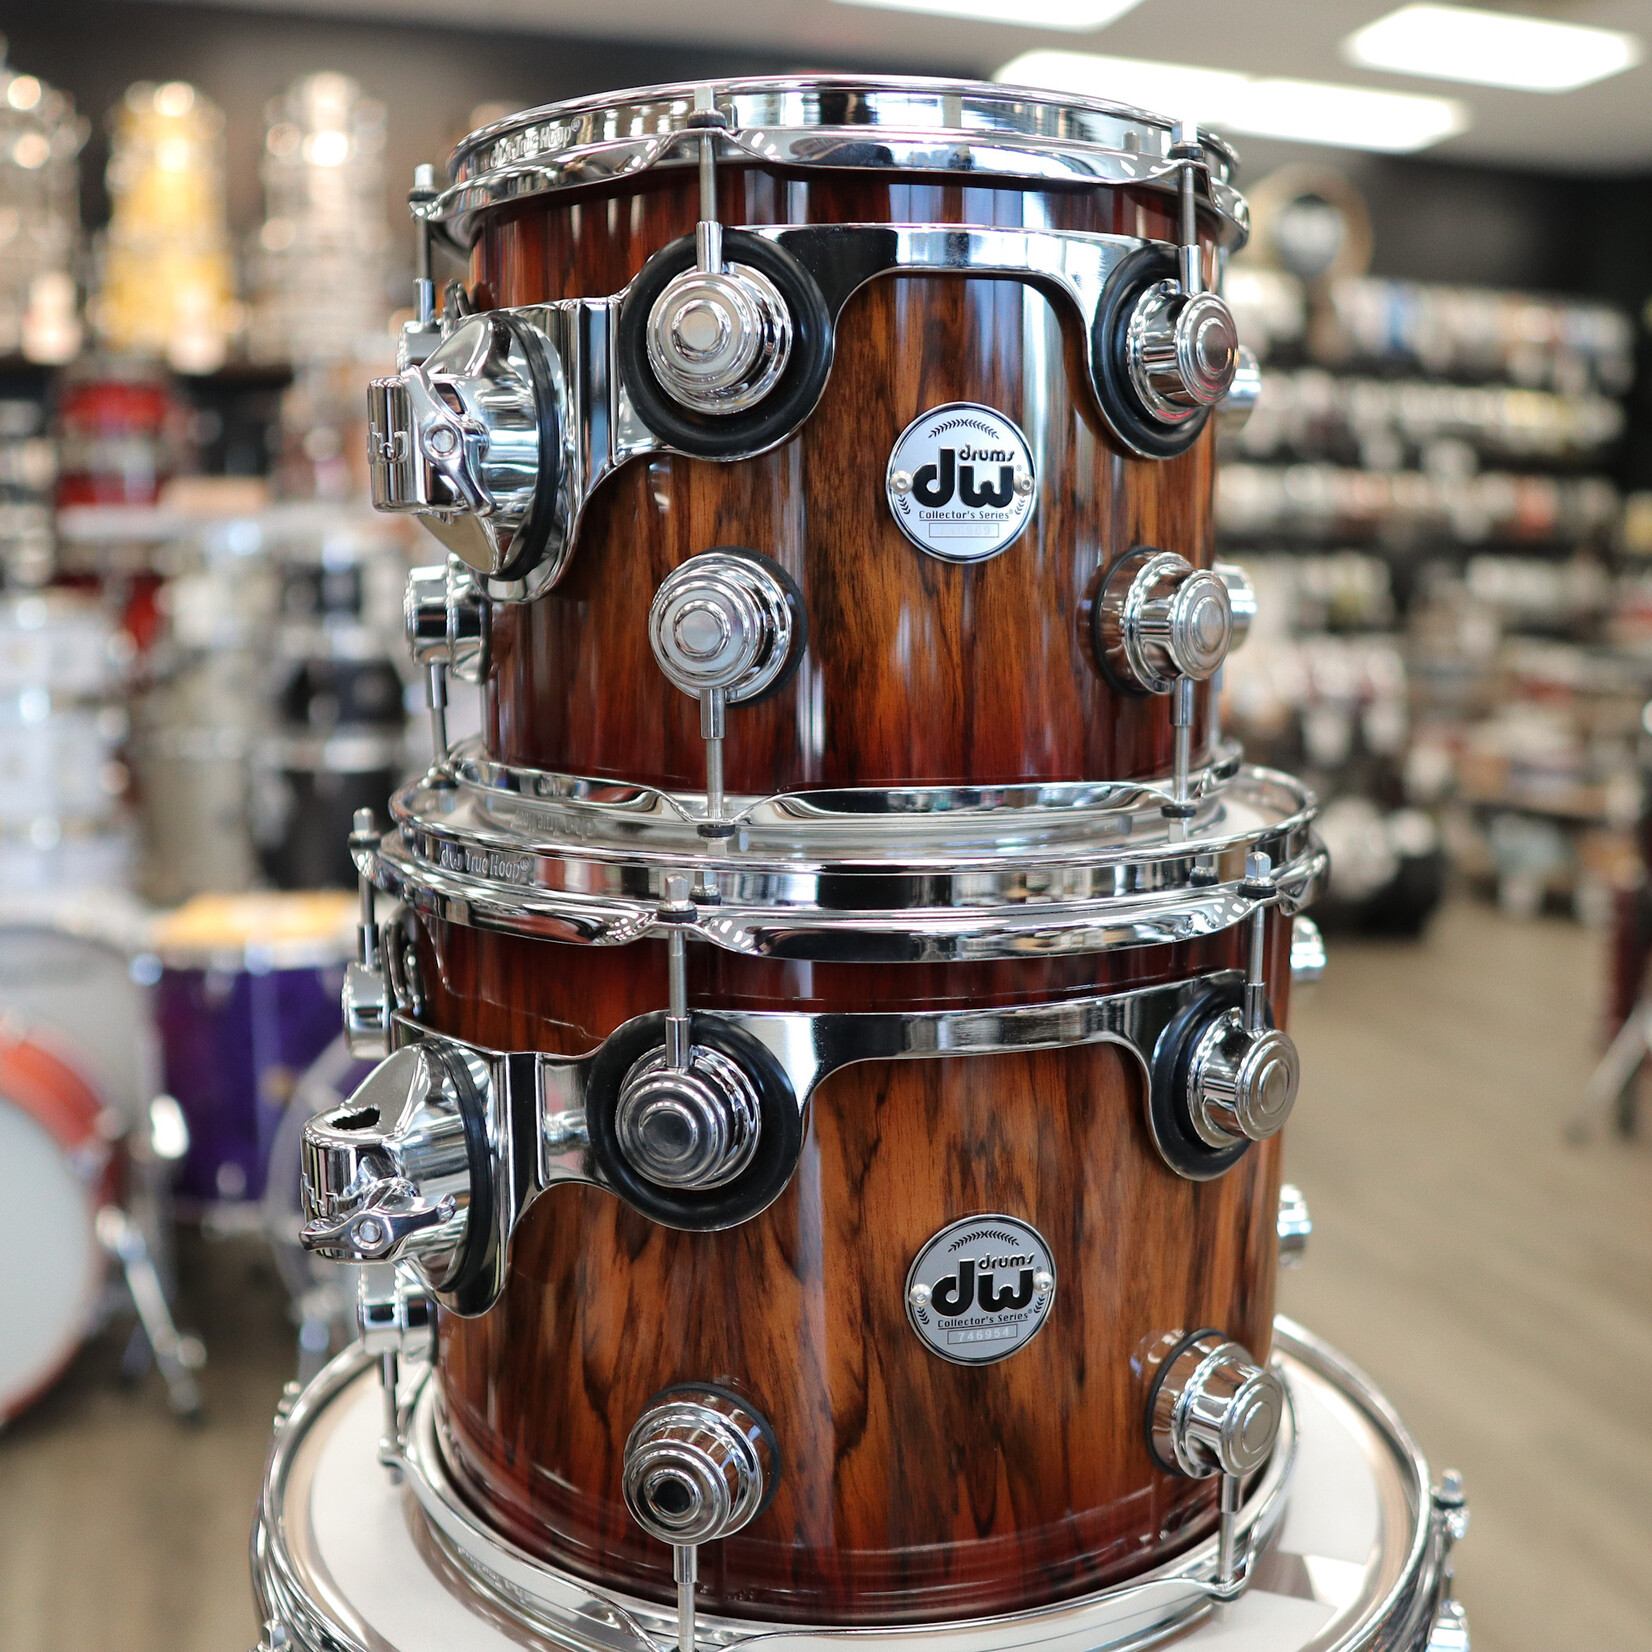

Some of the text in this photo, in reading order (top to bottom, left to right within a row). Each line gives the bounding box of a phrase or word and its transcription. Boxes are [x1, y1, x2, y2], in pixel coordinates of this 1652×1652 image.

[958, 443, 1015, 462] drums
[911, 446, 1015, 508] dw
[919, 510, 975, 519] Collector's
[978, 1252, 1035, 1270] drums
[930, 1258, 1034, 1317] dw
[937, 1315, 994, 1328] Collector's
[957, 1326, 1010, 1342] 746954
